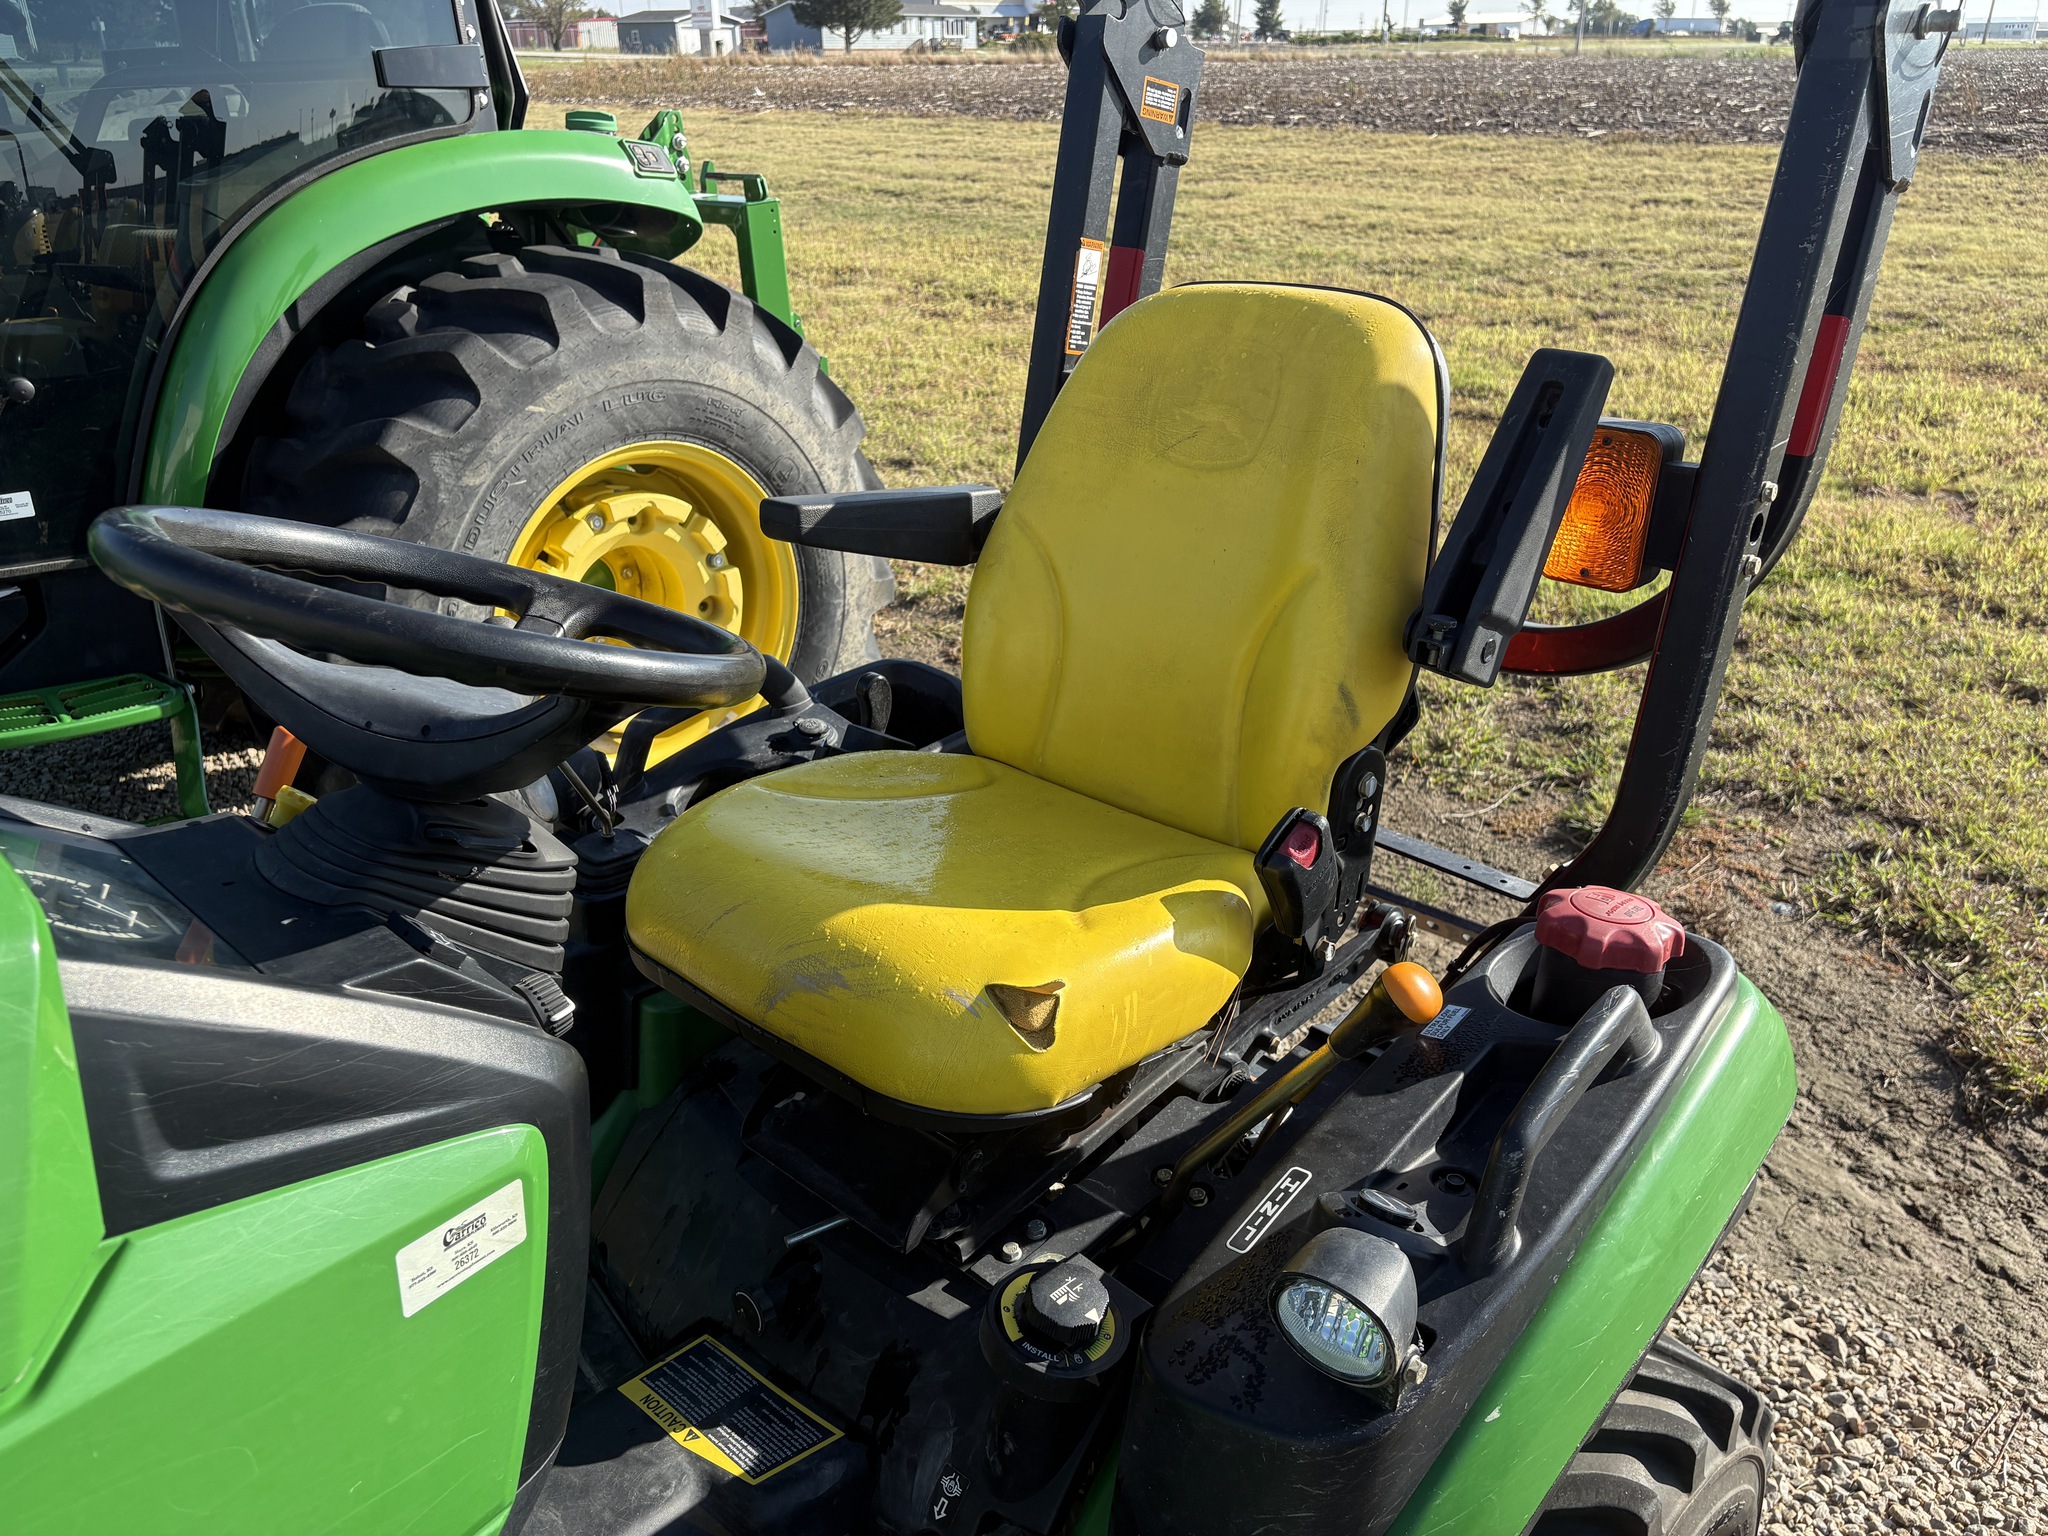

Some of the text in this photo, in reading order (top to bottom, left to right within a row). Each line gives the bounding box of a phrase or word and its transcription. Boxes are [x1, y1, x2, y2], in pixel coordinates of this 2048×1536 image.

[1142, 108, 1168, 121] WARNING
[1085, 241, 1103, 250] WARNING
[464, 411, 595, 553] DUSTRIAL
[1423, 1020, 1441, 1035] ULTRA
[1440, 1009, 1451, 1019] LOW
[1447, 1008, 1462, 1018] FUEL
[1437, 1025, 1452, 1038] ONLY
[443, 1215, 487, 1247] Carrico
[454, 1249, 480, 1270] 26372
[1022, 1341, 1060, 1363] INSTALL
[640, 1393, 686, 1434] CAUTION
